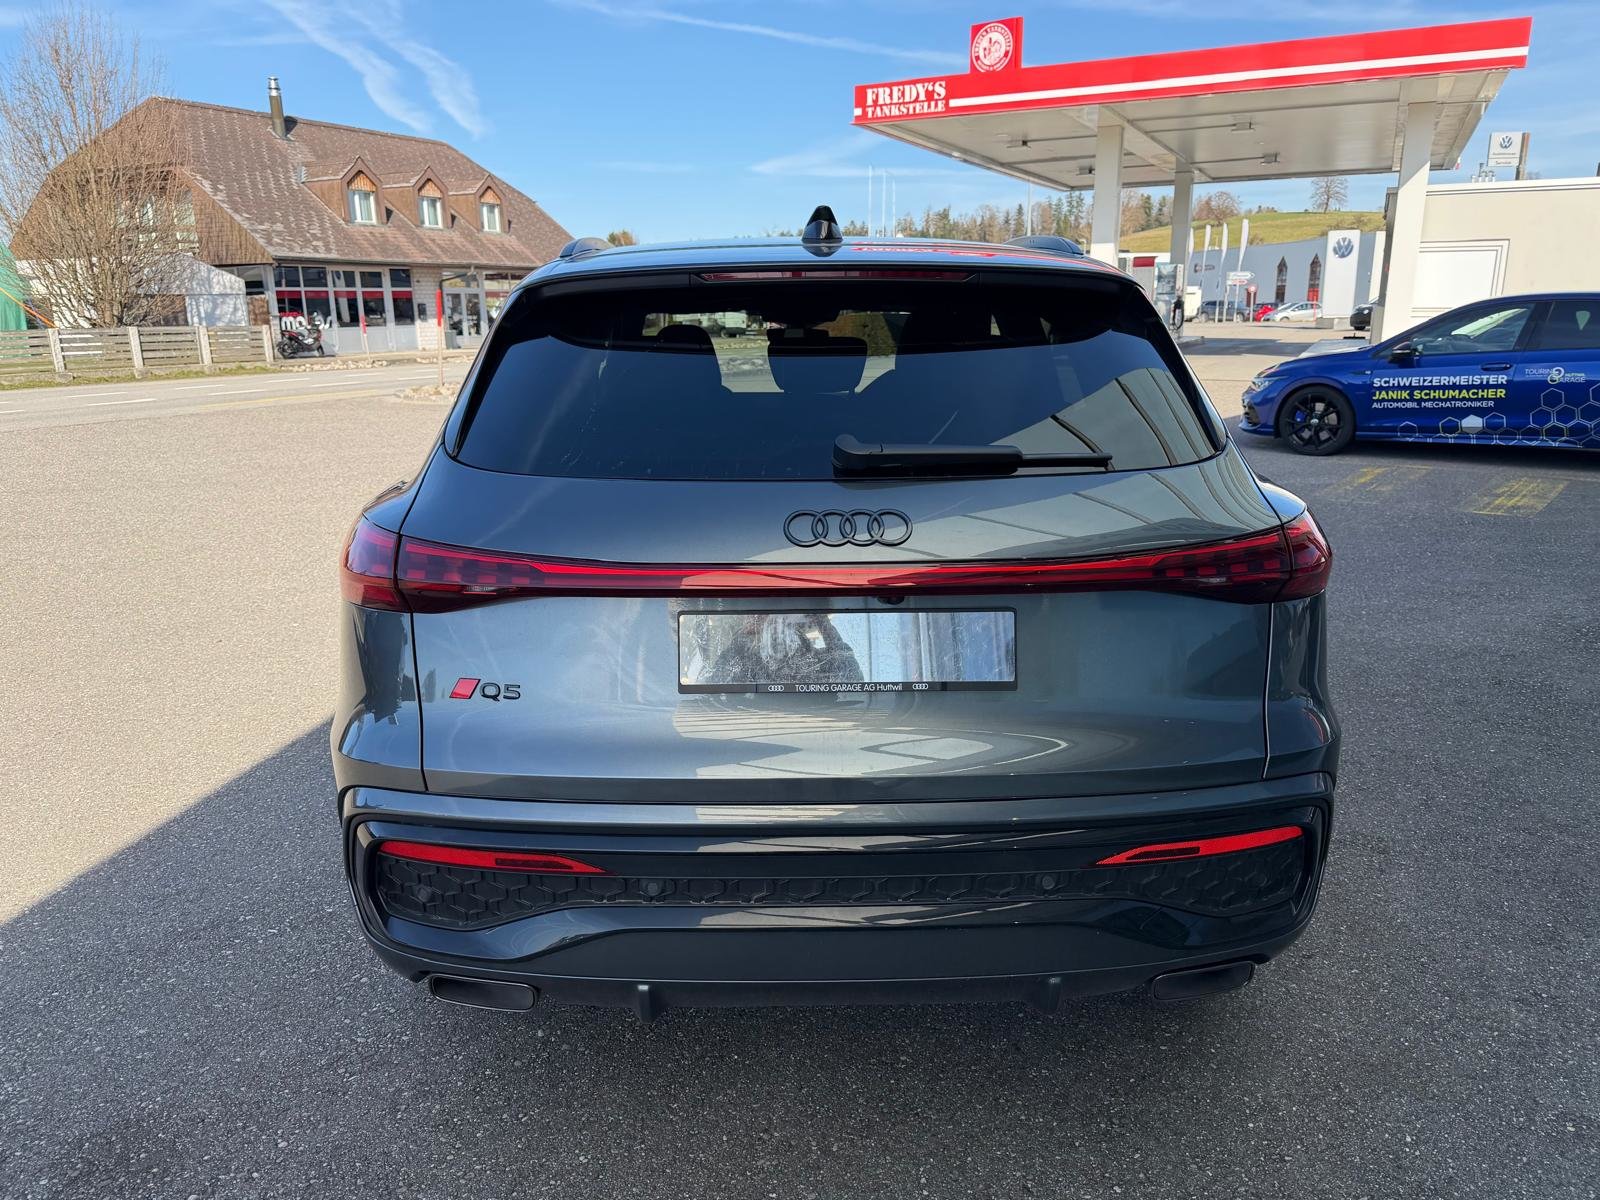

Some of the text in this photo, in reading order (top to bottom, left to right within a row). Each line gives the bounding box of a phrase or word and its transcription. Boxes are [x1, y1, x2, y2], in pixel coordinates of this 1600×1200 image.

[866, 81, 946, 106] FREDY'S
[866, 100, 946, 119] TANKSTELLE
[1373, 375, 1507, 387] SCHWEIZERMEISTER
[1372, 389, 1506, 400] JANIK SCHUMACHER
[1421, 400, 1495, 408] MECHATRONIKER
[479, 682, 521, 702] Q5
[794, 684, 830, 692] TOURING
[876, 683, 903, 691] Huttwil
